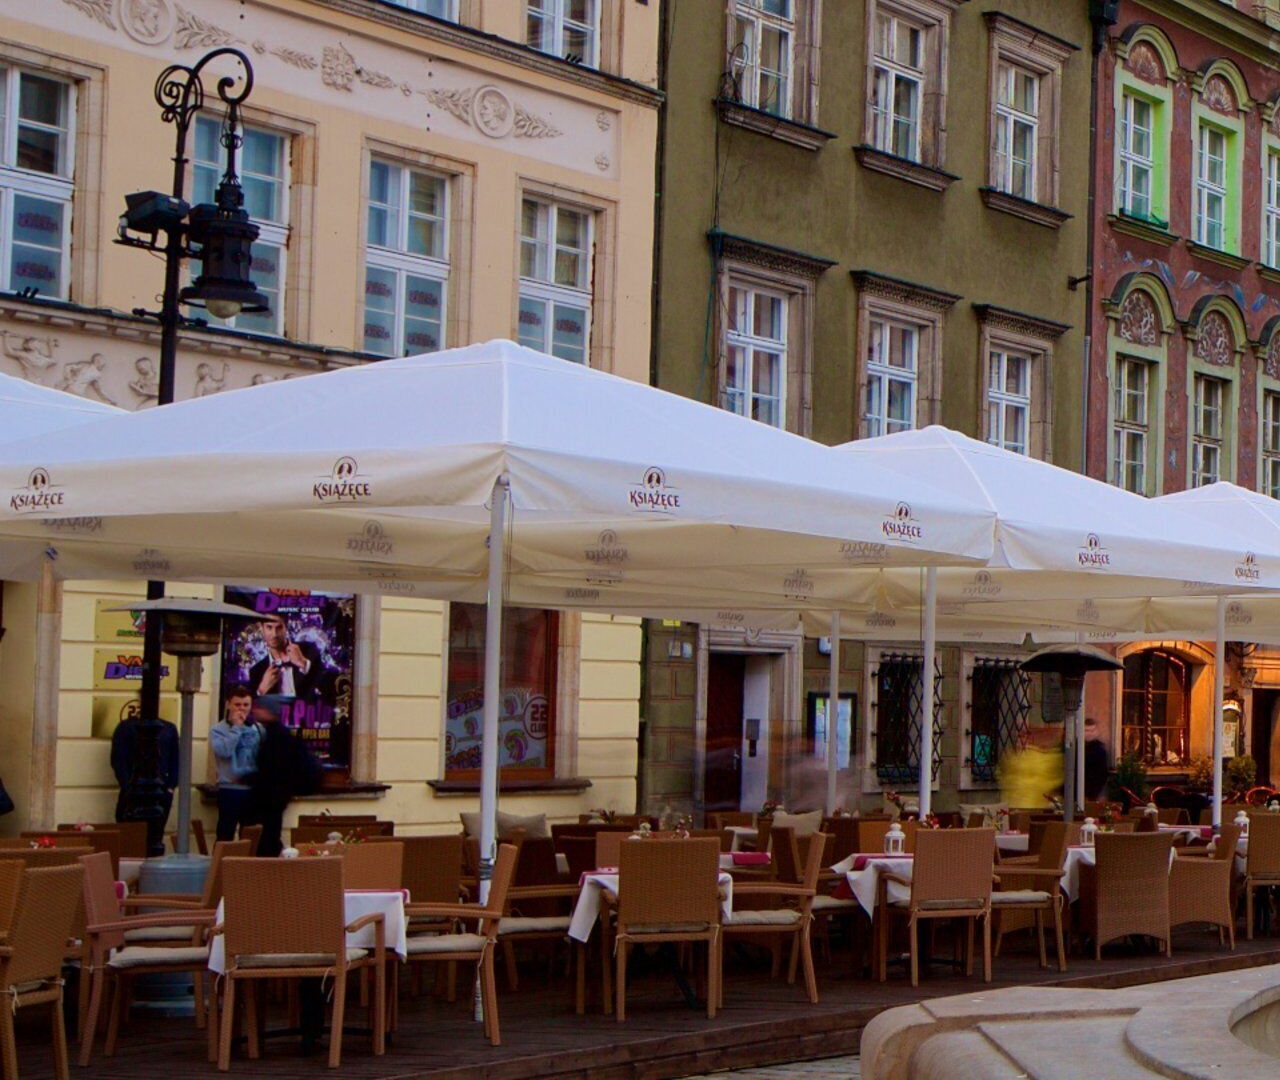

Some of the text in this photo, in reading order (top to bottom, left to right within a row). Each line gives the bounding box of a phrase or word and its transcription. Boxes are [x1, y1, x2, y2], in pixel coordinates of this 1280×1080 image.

[313, 480, 371, 500] KSIĄŻĘCE
[630, 490, 680, 509] KSIĄŻĘCE
[10, 491, 64, 510] KSIĄŻĘCE
[882, 520, 922, 539] KSIĄŻĘCE
[255, 591, 327, 612] DIESEL
[117, 655, 144, 667] VA
[530, 704, 548, 721] 22
